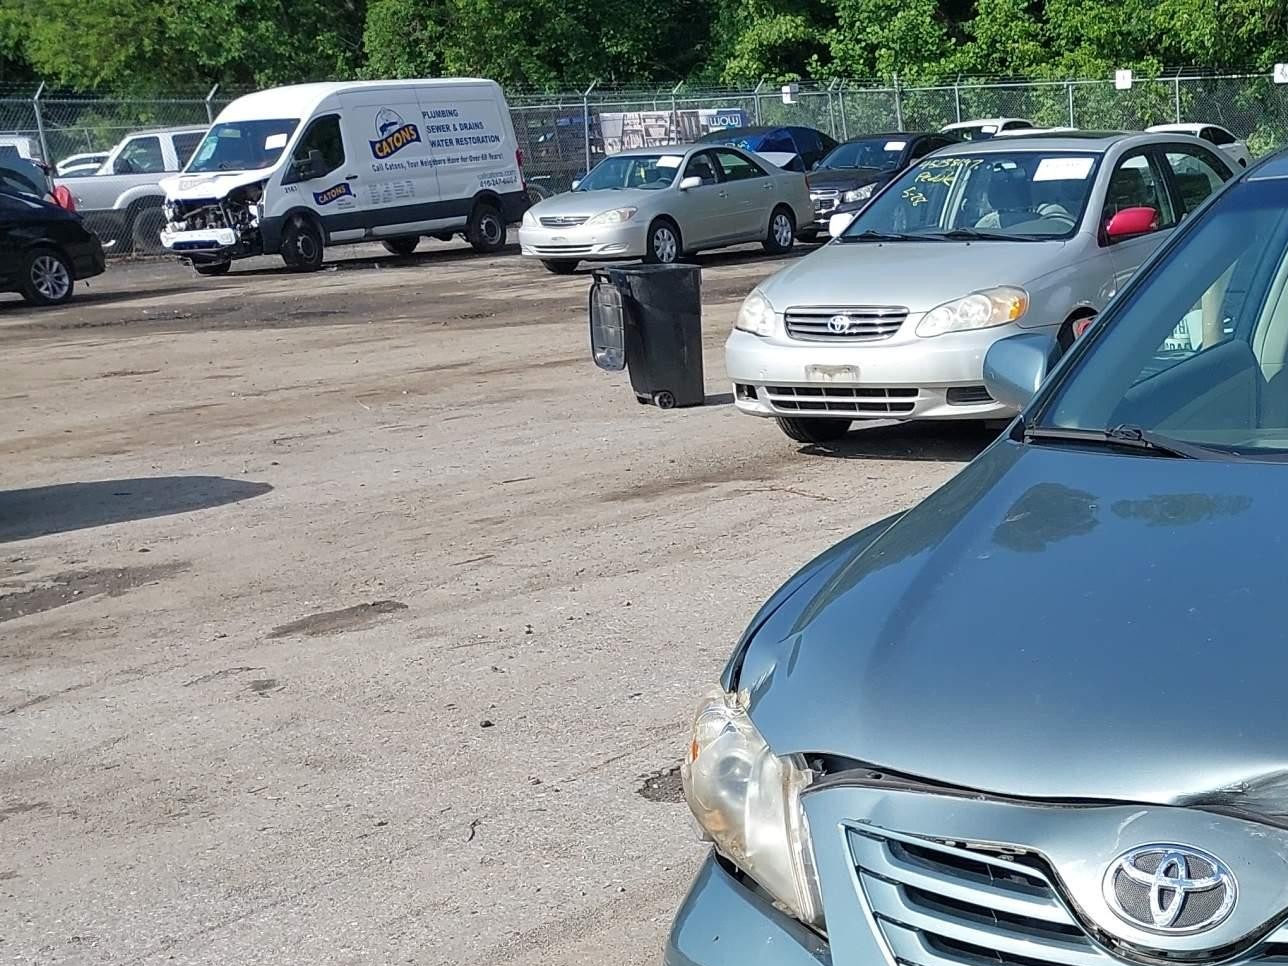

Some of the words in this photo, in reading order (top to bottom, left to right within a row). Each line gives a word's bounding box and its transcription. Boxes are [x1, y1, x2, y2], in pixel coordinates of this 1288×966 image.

[421, 109, 459, 119] PLUMBING
[426, 124, 451, 134] SEWER
[453, 123, 458, 132] &
[459, 121, 484, 131] DRAINS
[375, 126, 417, 157] CATONS
[430, 138, 454, 148] WATER
[456, 134, 501, 146] RESTORATION
[371, 163, 384, 173] Call
[319, 184, 346, 203] CATONS
